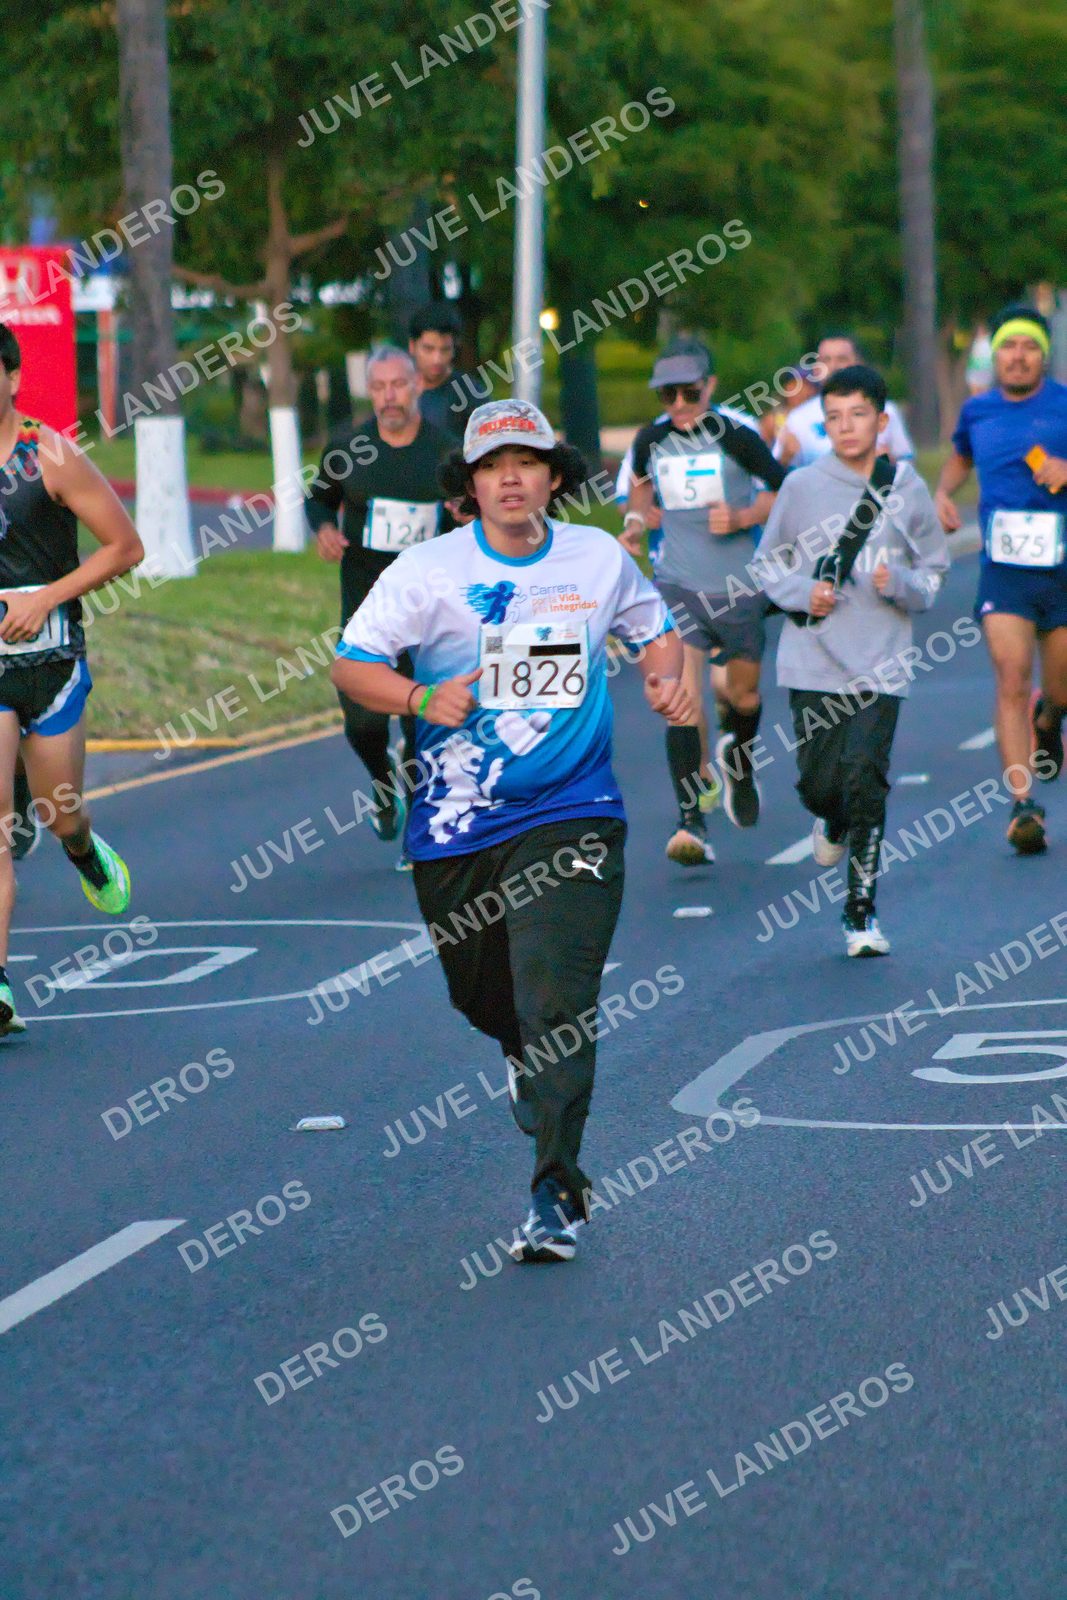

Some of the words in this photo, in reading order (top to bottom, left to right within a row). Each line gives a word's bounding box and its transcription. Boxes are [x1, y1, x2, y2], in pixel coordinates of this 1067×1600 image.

[684, 479, 697, 502] 5
[1001, 533, 1045, 558] 875
[530, 583, 578, 596] Carrera
[559, 593, 580, 602] Vida
[550, 601, 597, 613] Integridad
[489, 659, 585, 698] 1826
